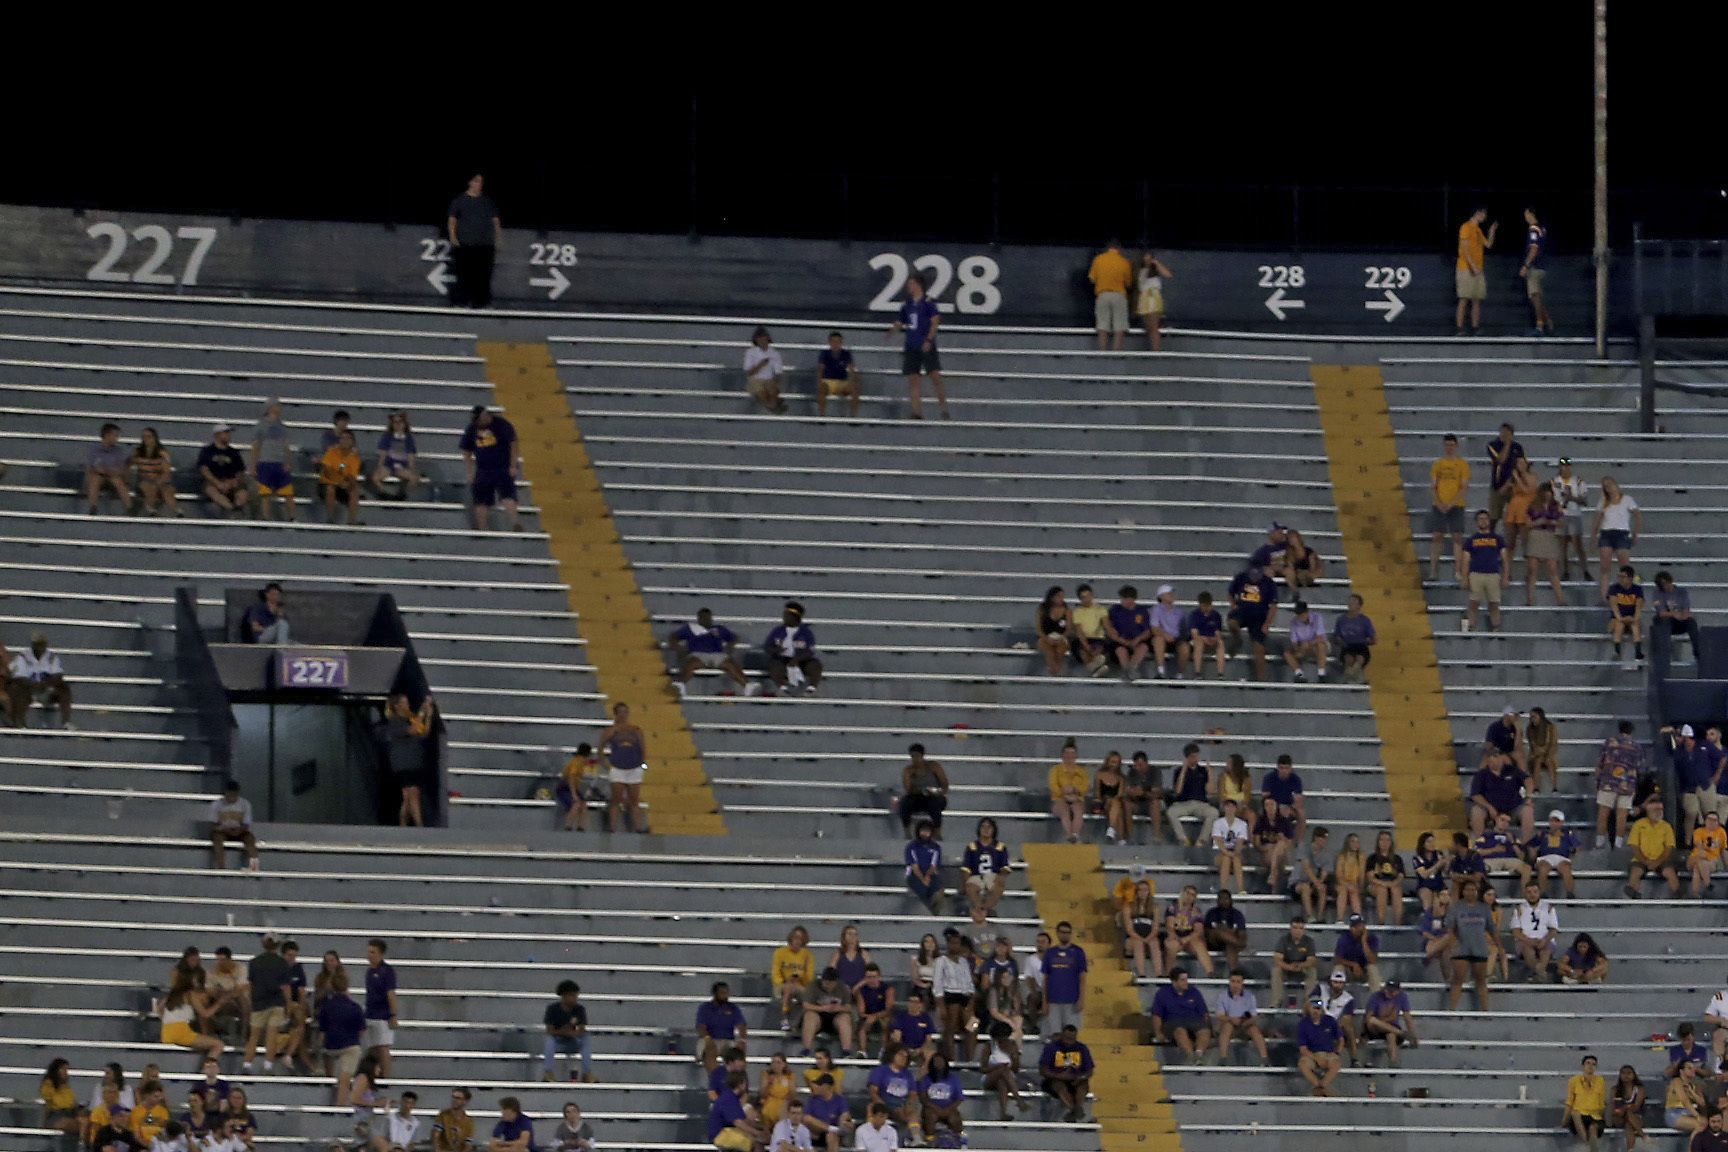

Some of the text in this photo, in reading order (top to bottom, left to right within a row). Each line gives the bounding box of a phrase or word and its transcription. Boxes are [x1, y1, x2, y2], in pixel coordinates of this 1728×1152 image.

[86, 223, 217, 286] 227
[420, 240, 453, 263] 22
[529, 243, 576, 267] 228
[869, 252, 1001, 315] 228
[1258, 266, 1306, 288] 228
[1365, 266, 1411, 289] 229
[292, 661, 338, 683] 227
[979, 855, 993, 874] 2
